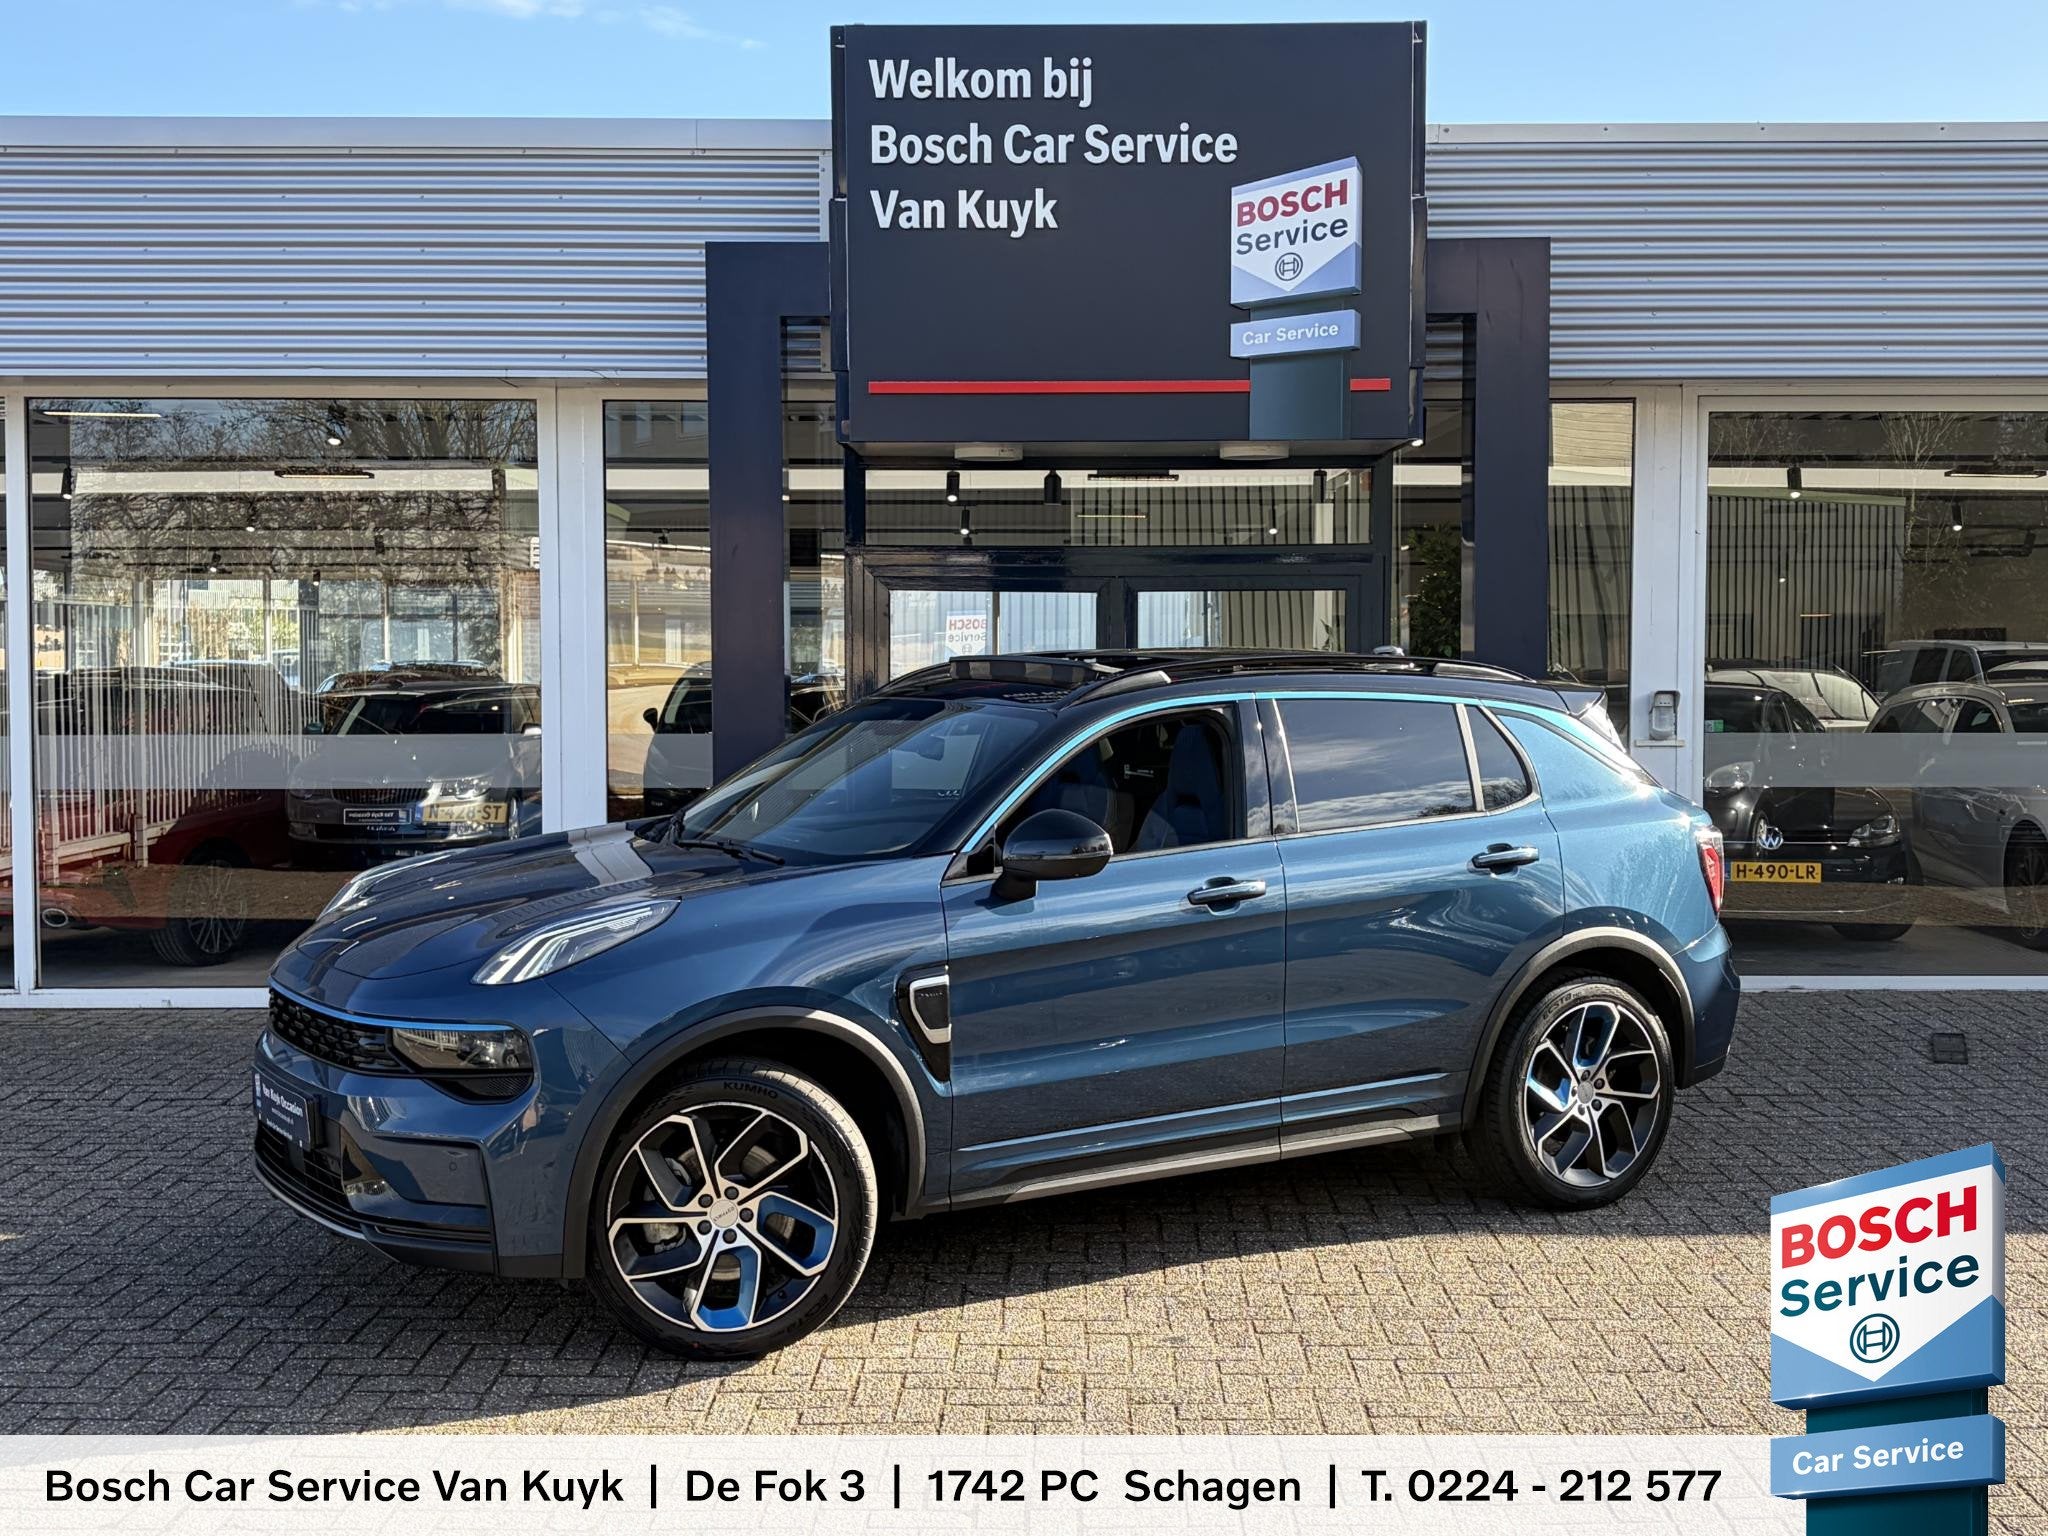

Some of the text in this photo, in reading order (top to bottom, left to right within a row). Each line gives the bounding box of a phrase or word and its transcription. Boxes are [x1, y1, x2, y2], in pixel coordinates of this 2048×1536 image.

[869, 57, 1092, 108] Welkom bij
[871, 123, 1238, 164] Bosch Car Service
[870, 188, 1059, 238] Van Kuyk
[1237, 179, 1348, 227] BOSCH
[1236, 218, 1348, 255] Service
[1242, 323, 1339, 346] Car Service
[1736, 864, 1816, 879] H-490-LR
[723, 1081, 778, 1099] KUMHO
